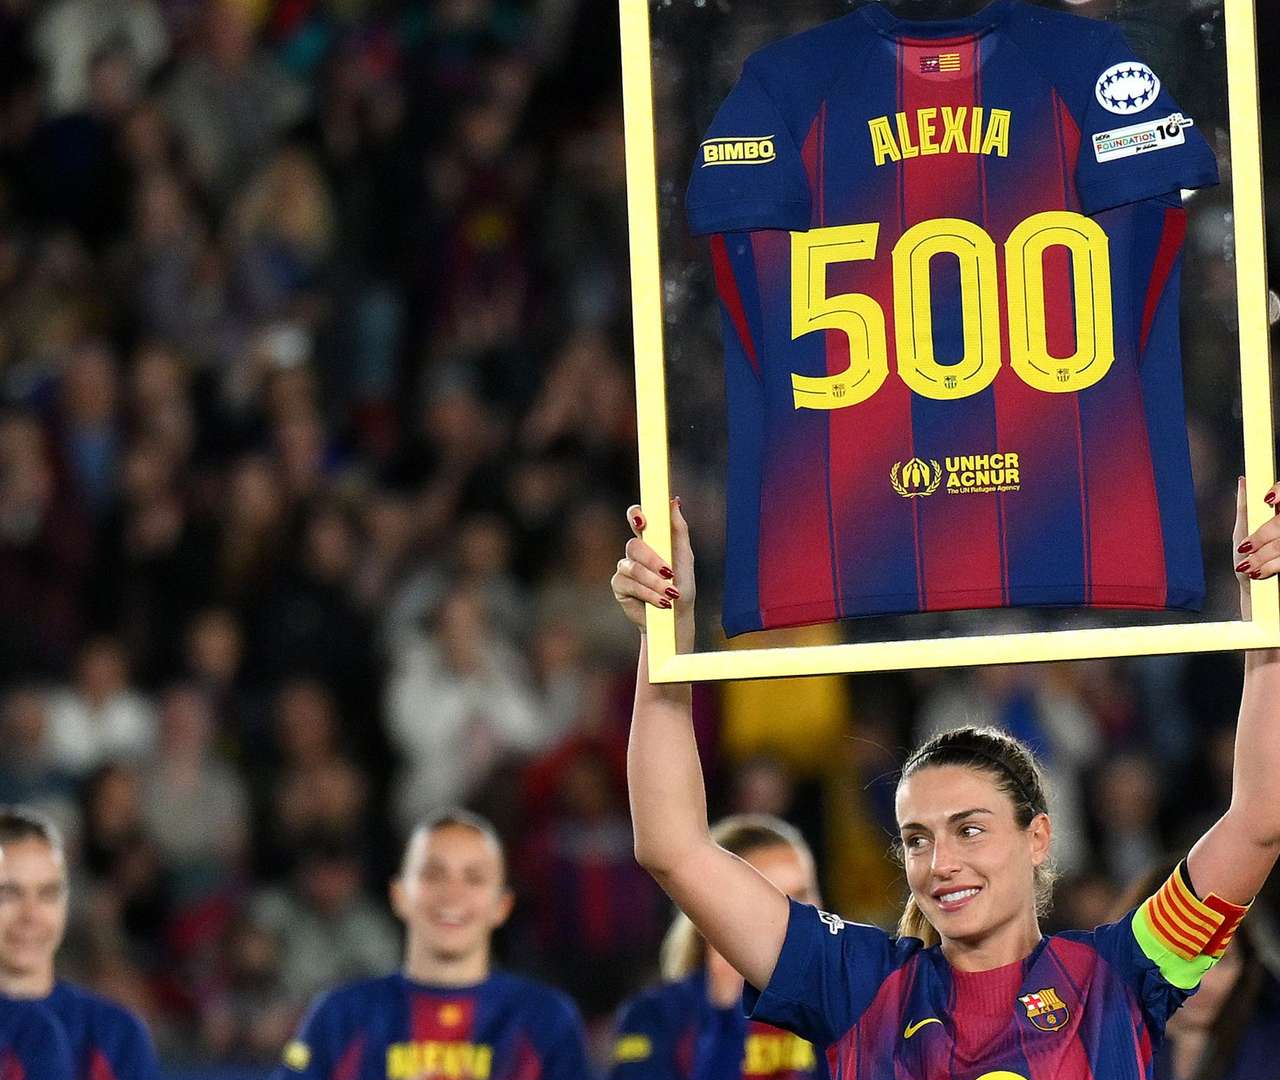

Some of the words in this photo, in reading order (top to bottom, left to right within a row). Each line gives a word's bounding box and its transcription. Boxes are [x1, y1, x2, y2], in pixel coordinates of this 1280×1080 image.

[867, 105, 1013, 166] ALEXIA
[1096, 132, 1156, 152] FOUNDATION
[703, 140, 774, 163] BIMBO
[789, 210, 1115, 410] 500
[945, 453, 1019, 472] UNHCR
[946, 469, 1020, 487] ACNUR
